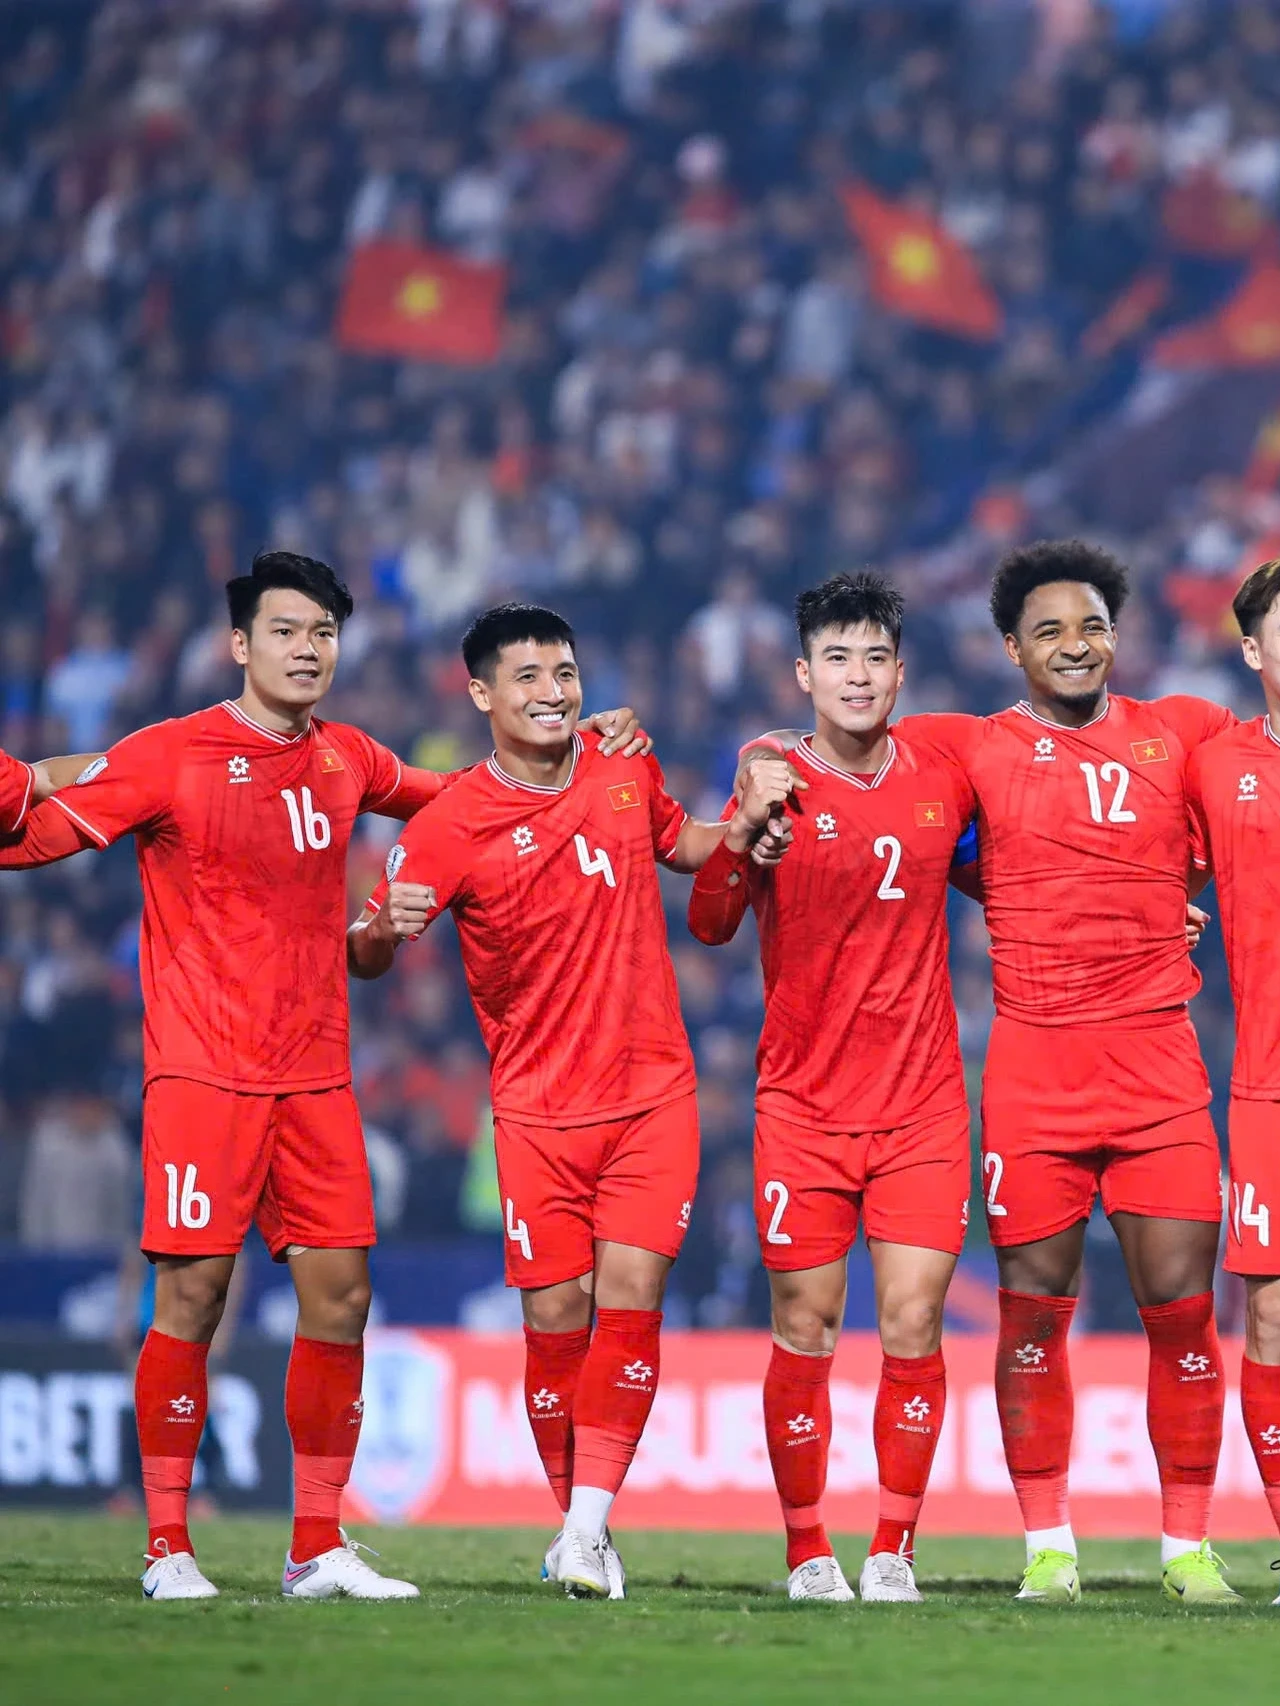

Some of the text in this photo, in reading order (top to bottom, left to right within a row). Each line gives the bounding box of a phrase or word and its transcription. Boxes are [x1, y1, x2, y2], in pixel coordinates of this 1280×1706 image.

[280, 786, 331, 853] 16
[1079, 761, 1137, 823] 12
[573, 833, 617, 888] 4
[873, 835, 906, 900] 2
[164, 1163, 211, 1229] 16
[764, 1180, 792, 1245] 2
[981, 1151, 1008, 1216] 2
[1233, 1182, 1270, 1247] 14
[506, 1197, 533, 1261] 4
